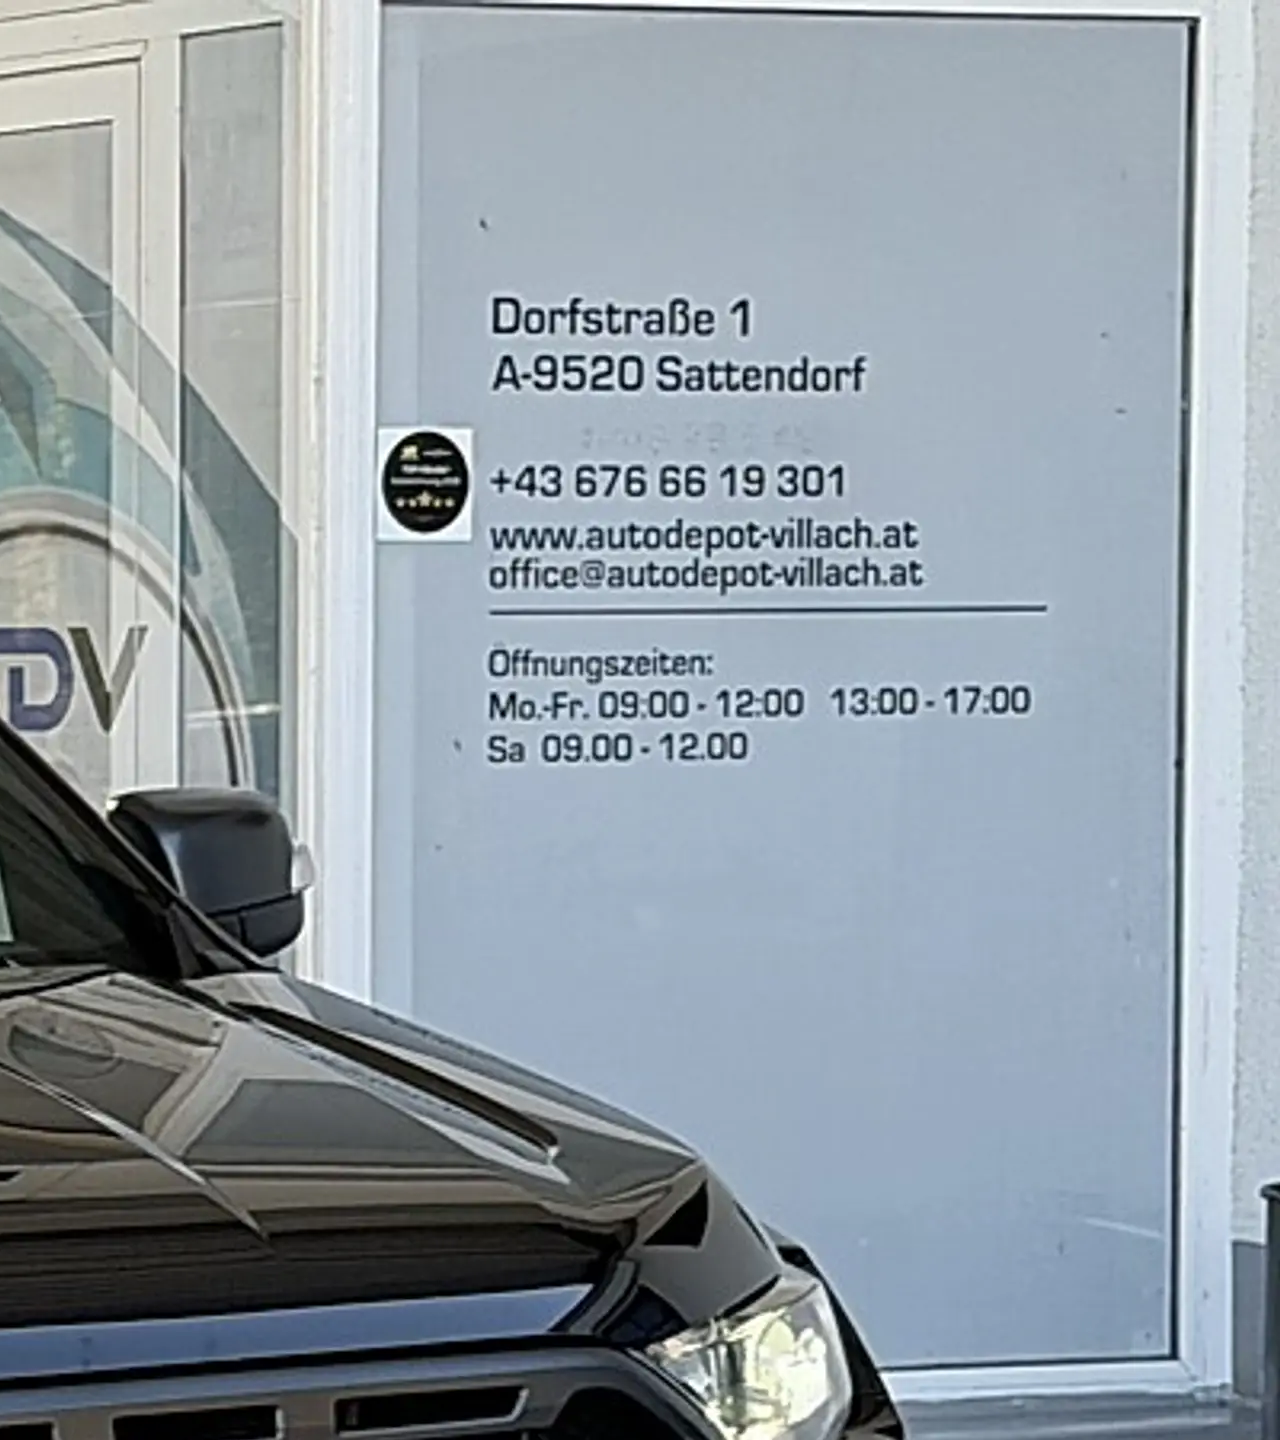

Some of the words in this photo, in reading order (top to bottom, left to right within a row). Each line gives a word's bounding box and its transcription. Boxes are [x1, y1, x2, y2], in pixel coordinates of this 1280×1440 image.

[491, 297, 715, 337] Dorfstraße
[729, 298, 751, 337] 1
[491, 353, 644, 392] A-9520
[655, 354, 866, 392] Sattendorf
[489, 464, 562, 498] +43
[574, 464, 647, 498] 676
[658, 464, 706, 498] 66
[718, 464, 766, 498] 19
[776, 463, 844, 497] 301
[488, 517, 919, 557] www.autodepot-villach.at
[488, 556, 924, 596] office@autodepot-villach.at
[488, 690, 590, 720] Mo.-Fr.
[486, 734, 525, 763] Sa
[540, 732, 633, 762] 09.00
[658, 731, 748, 761] 12.00
